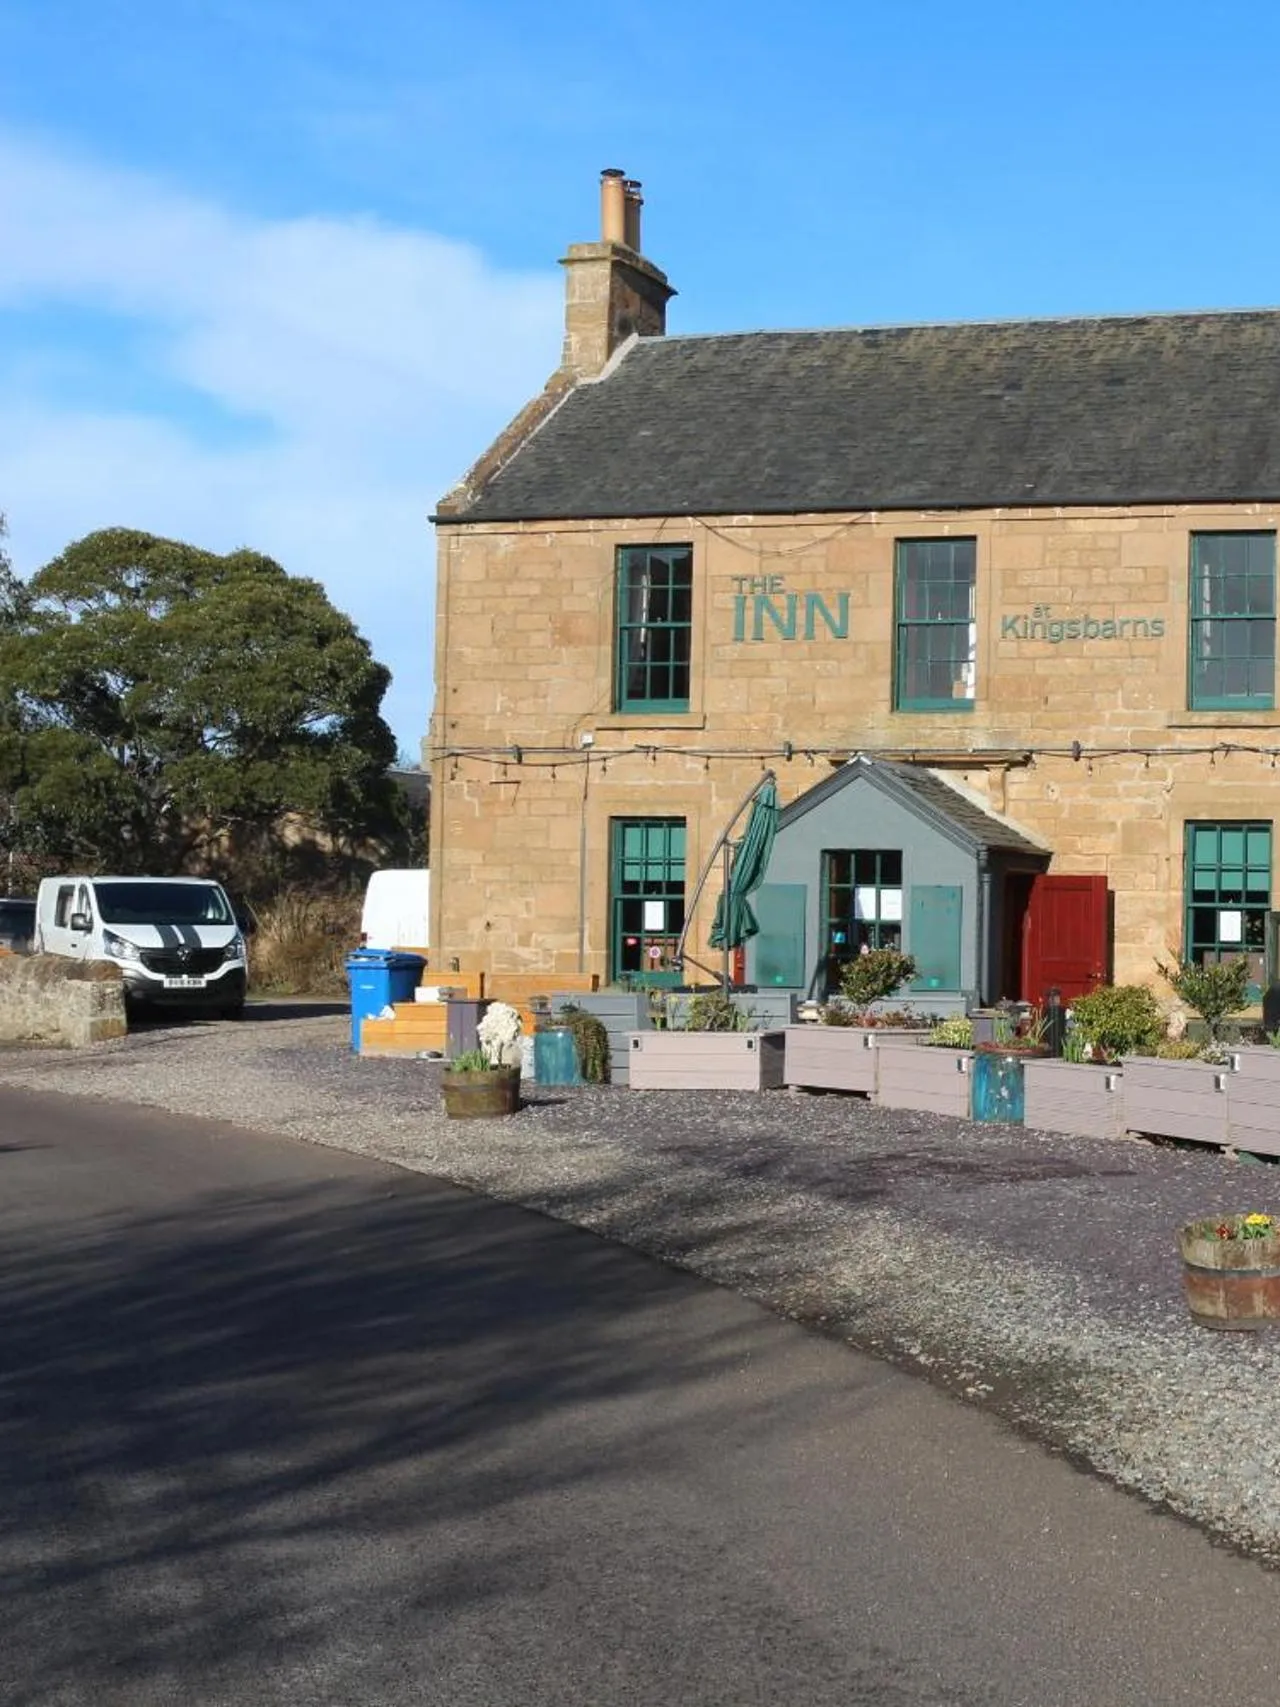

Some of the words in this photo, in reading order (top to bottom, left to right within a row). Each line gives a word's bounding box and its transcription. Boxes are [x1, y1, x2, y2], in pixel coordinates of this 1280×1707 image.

[731, 575, 785, 595] THE
[732, 592, 851, 642] INN
[1033, 603, 1051, 618] at
[1000, 615, 1165, 643] Kingsbarns
